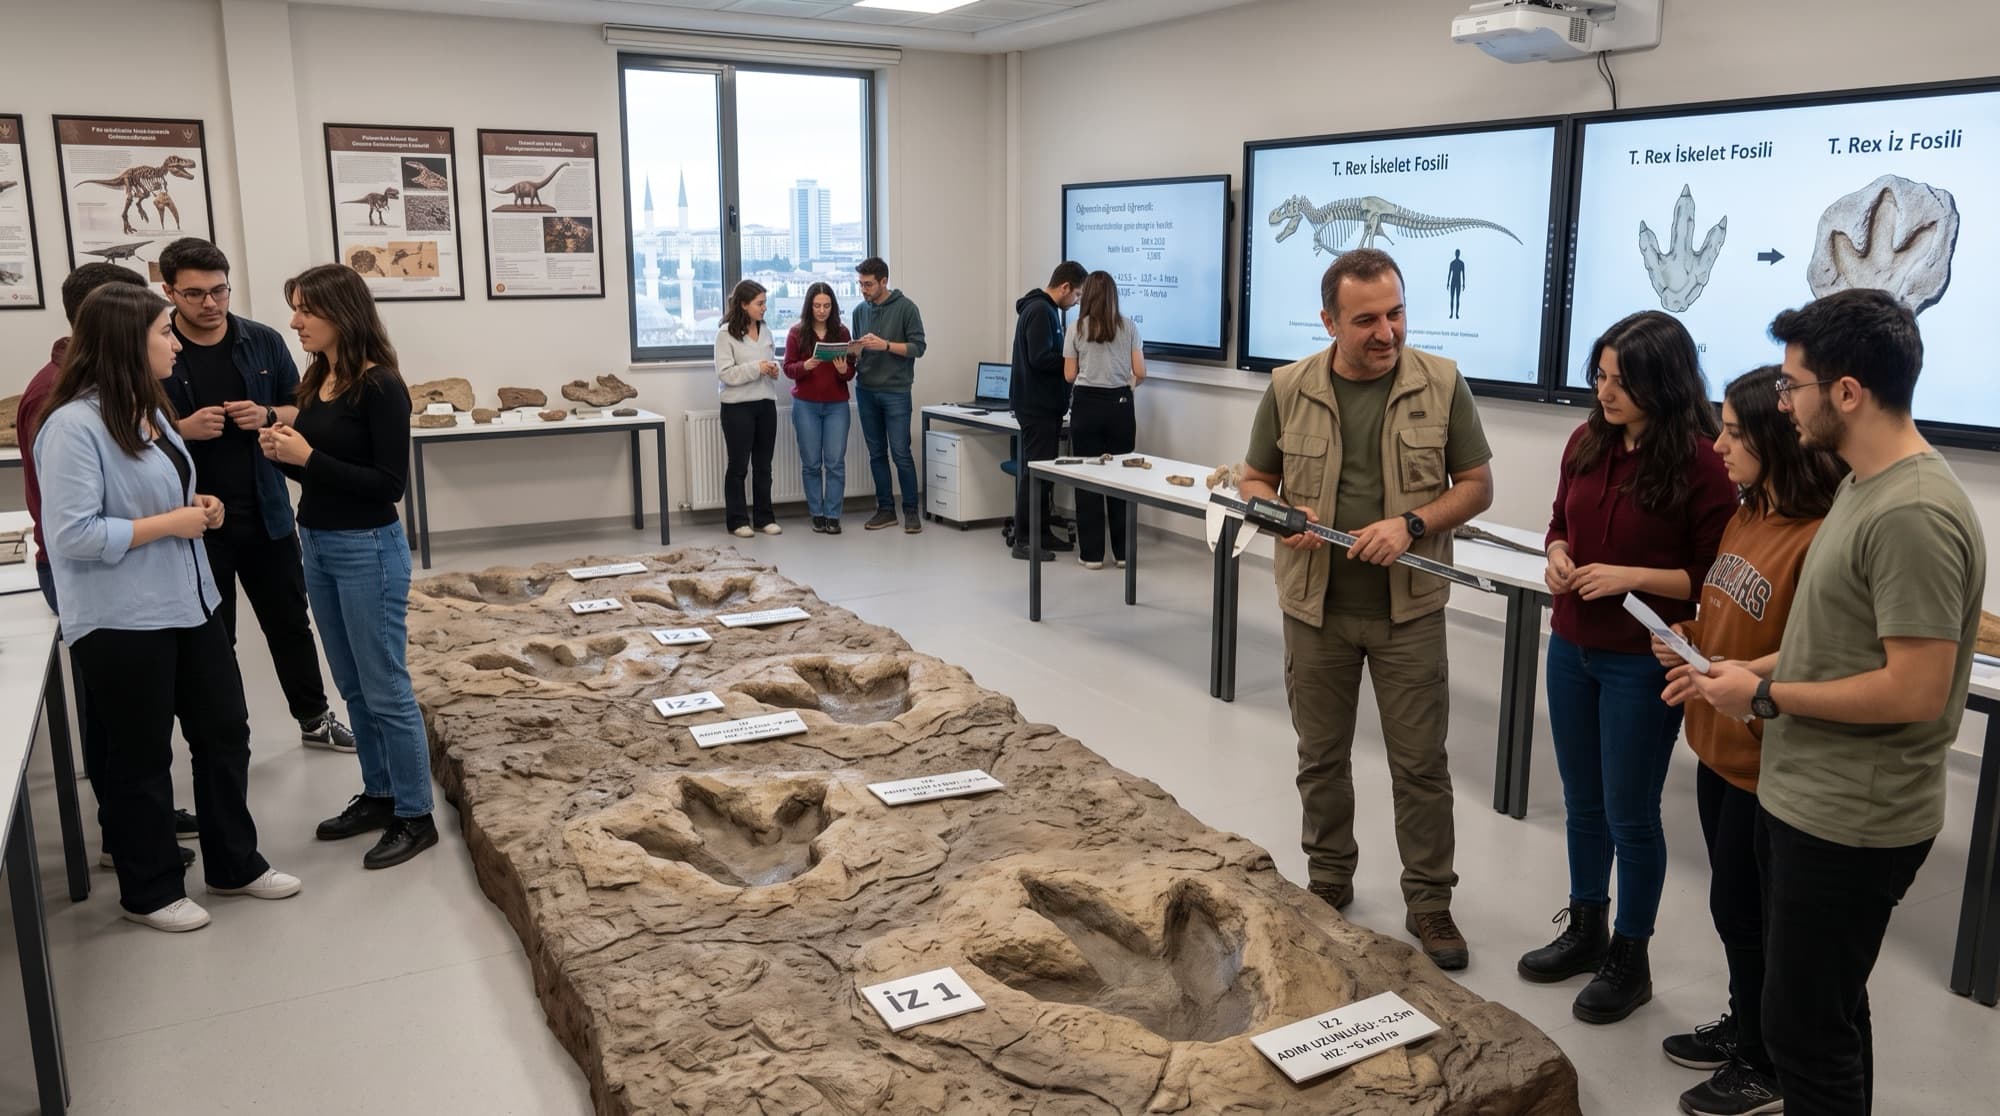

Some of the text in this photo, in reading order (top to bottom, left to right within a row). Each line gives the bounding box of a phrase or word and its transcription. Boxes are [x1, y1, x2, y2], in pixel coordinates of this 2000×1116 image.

[1828, 129, 1962, 154] T. Rex İz Fosili
[1629, 141, 1773, 165] T. Rex İskelet Fosili
[1332, 153, 1449, 176] T. Rex İskelet Fosili
[693, 697, 712, 705] 2
[933, 982, 961, 1001] 1
[1331, 1017, 1343, 1026] 2
[1278, 1044, 1312, 1061] ADIM
[1320, 1048, 1347, 1061] HIZ:
[1346, 1040, 1364, 1049] ~6
